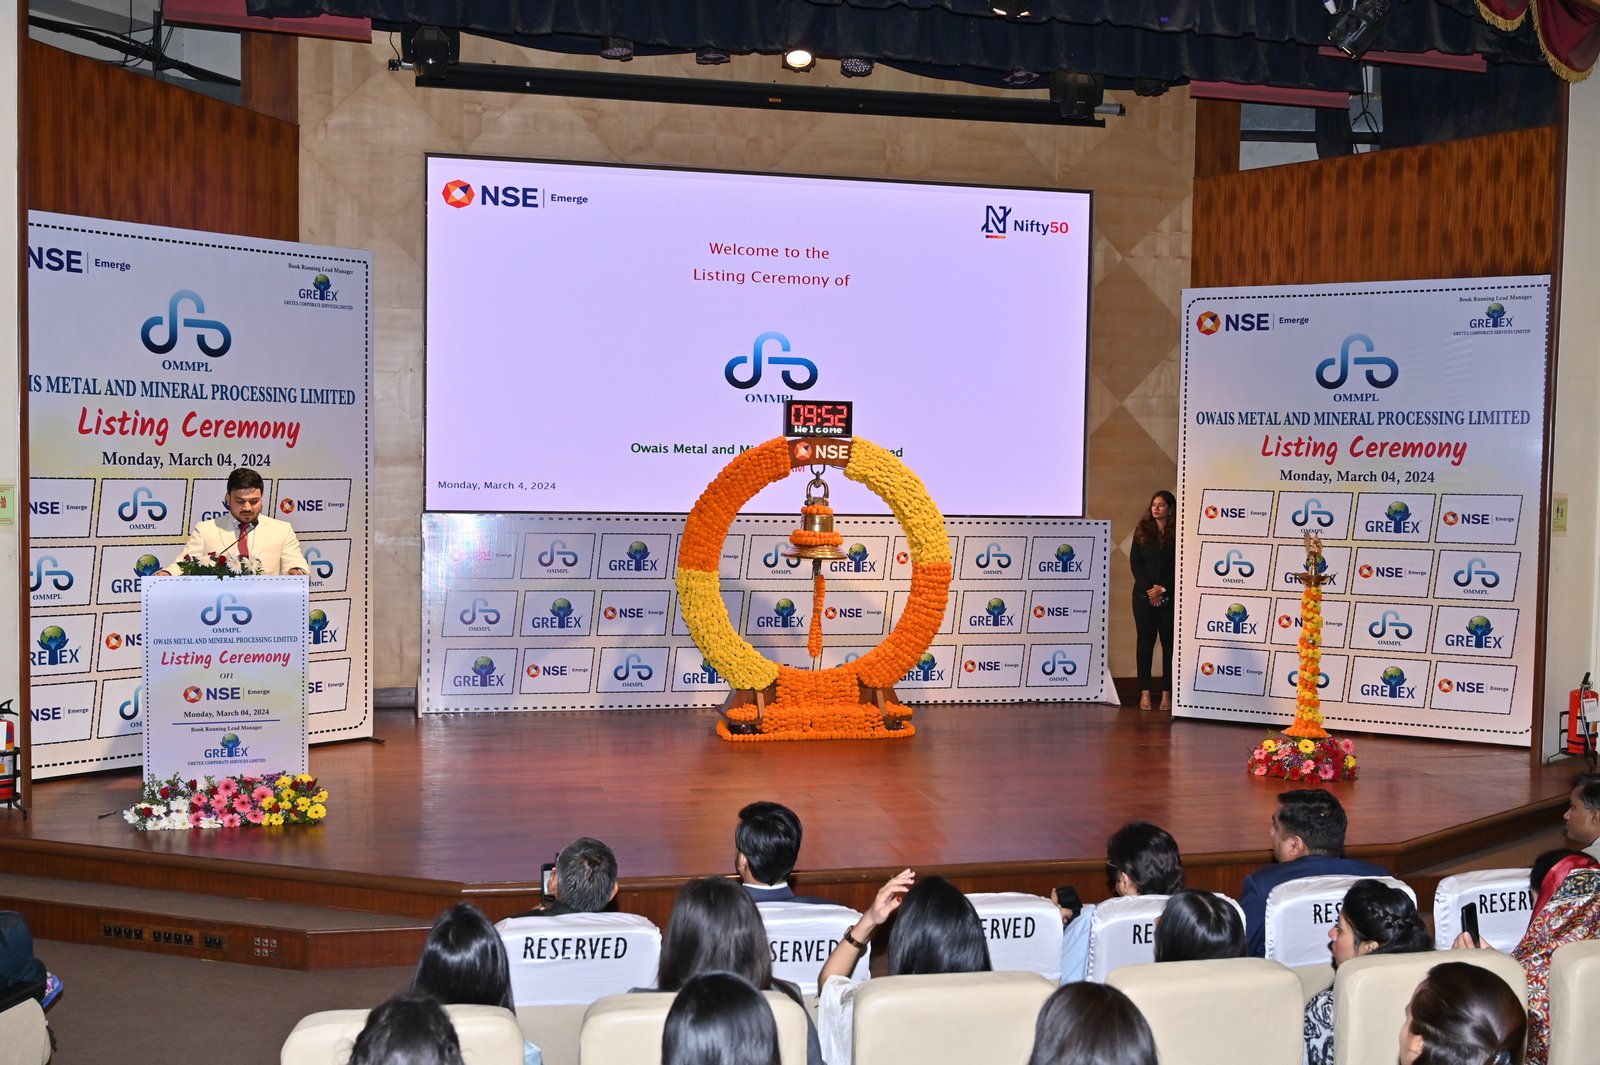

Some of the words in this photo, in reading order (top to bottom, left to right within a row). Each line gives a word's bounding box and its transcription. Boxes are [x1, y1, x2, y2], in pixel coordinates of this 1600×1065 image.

[480, 185, 538, 208] NSE
[550, 194, 588, 205] Emerge
[1014, 220, 1069, 236] Nifty50
[709, 242, 779, 258] Welcome
[784, 246, 800, 258] to
[806, 246, 830, 260] the
[28, 246, 83, 274] NSE
[94, 257, 131, 271] Emerge
[693, 268, 746, 284] Listing
[751, 272, 830, 288] Ceremony
[834, 274, 850, 287] of
[1224, 313, 1270, 332] NSE
[1278, 316, 1309, 326] Emerge
[161, 360, 212, 372] OMMPL
[46, 376, 102, 395] METAL
[104, 379, 136, 396] AND
[140, 380, 208, 400] MINERAL
[211, 384, 298, 404] PROCESSING
[300, 388, 356, 406] LIMITED
[1333, 392, 1380, 402] OMMPL
[791, 404, 848, 426] 09:52
[1196, 412, 1235, 426] OWAIS
[1238, 412, 1281, 426] METAL
[1284, 412, 1310, 426] AND
[1314, 411, 1374, 426] MINERAL
[1378, 410, 1465, 426] PROCESSING
[1468, 410, 1530, 425] LIMITED
[77, 406, 168, 446] Listing
[182, 411, 300, 448] Ceremony
[794, 426, 842, 434] Welcome
[630, 442, 668, 454] Owais
[673, 443, 707, 454] Metal
[712, 443, 735, 455] and
[816, 444, 848, 459] NSE
[1261, 434, 1338, 465] Listing
[1349, 435, 1468, 466] Ceremony
[102, 451, 164, 468] Monday,
[168, 452, 213, 466] March
[216, 453, 237, 469] 04,
[240, 454, 271, 466] 2024
[1280, 468, 1332, 484] Monday,
[1336, 470, 1378, 482] March
[1381, 470, 1400, 485] 04,
[1404, 471, 1434, 483] 2024
[438, 480, 481, 490] Monday,
[484, 481, 514, 490] March
[518, 482, 527, 492] 4,
[530, 482, 556, 490] 2024
[29, 502, 60, 514] NSE
[297, 500, 322, 512] NSE
[1220, 507, 1246, 518] NSE
[1461, 514, 1489, 524] NSE
[1376, 567, 1403, 578] NSE
[111, 579, 142, 593] GRE
[620, 608, 644, 618] NSE
[839, 608, 862, 618] NSE
[1047, 606, 1069, 616] NSE
[126, 634, 142, 646] NS
[153, 638, 172, 646] OWAIS
[208, 636, 235, 644] MINERAL
[236, 636, 272, 644] PROCESSING
[161, 651, 212, 669] Listing
[219, 650, 291, 667] Ceremony
[978, 661, 1000, 671] NSE
[220, 672, 234, 680] on
[542, 666, 568, 676] NSE
[1216, 665, 1242, 676] NSE
[206, 687, 240, 700] NSE
[308, 682, 322, 694] SE
[1456, 682, 1484, 693] NSE
[30, 707, 61, 722] NSE
[184, 710, 214, 718] Monday,
[240, 710, 252, 718] 04,
[1479, 890, 1534, 914] RESER
[980, 916, 1036, 940] ERVED
[522, 936, 628, 961] RESERVED
[770, 940, 839, 962] SERVE
